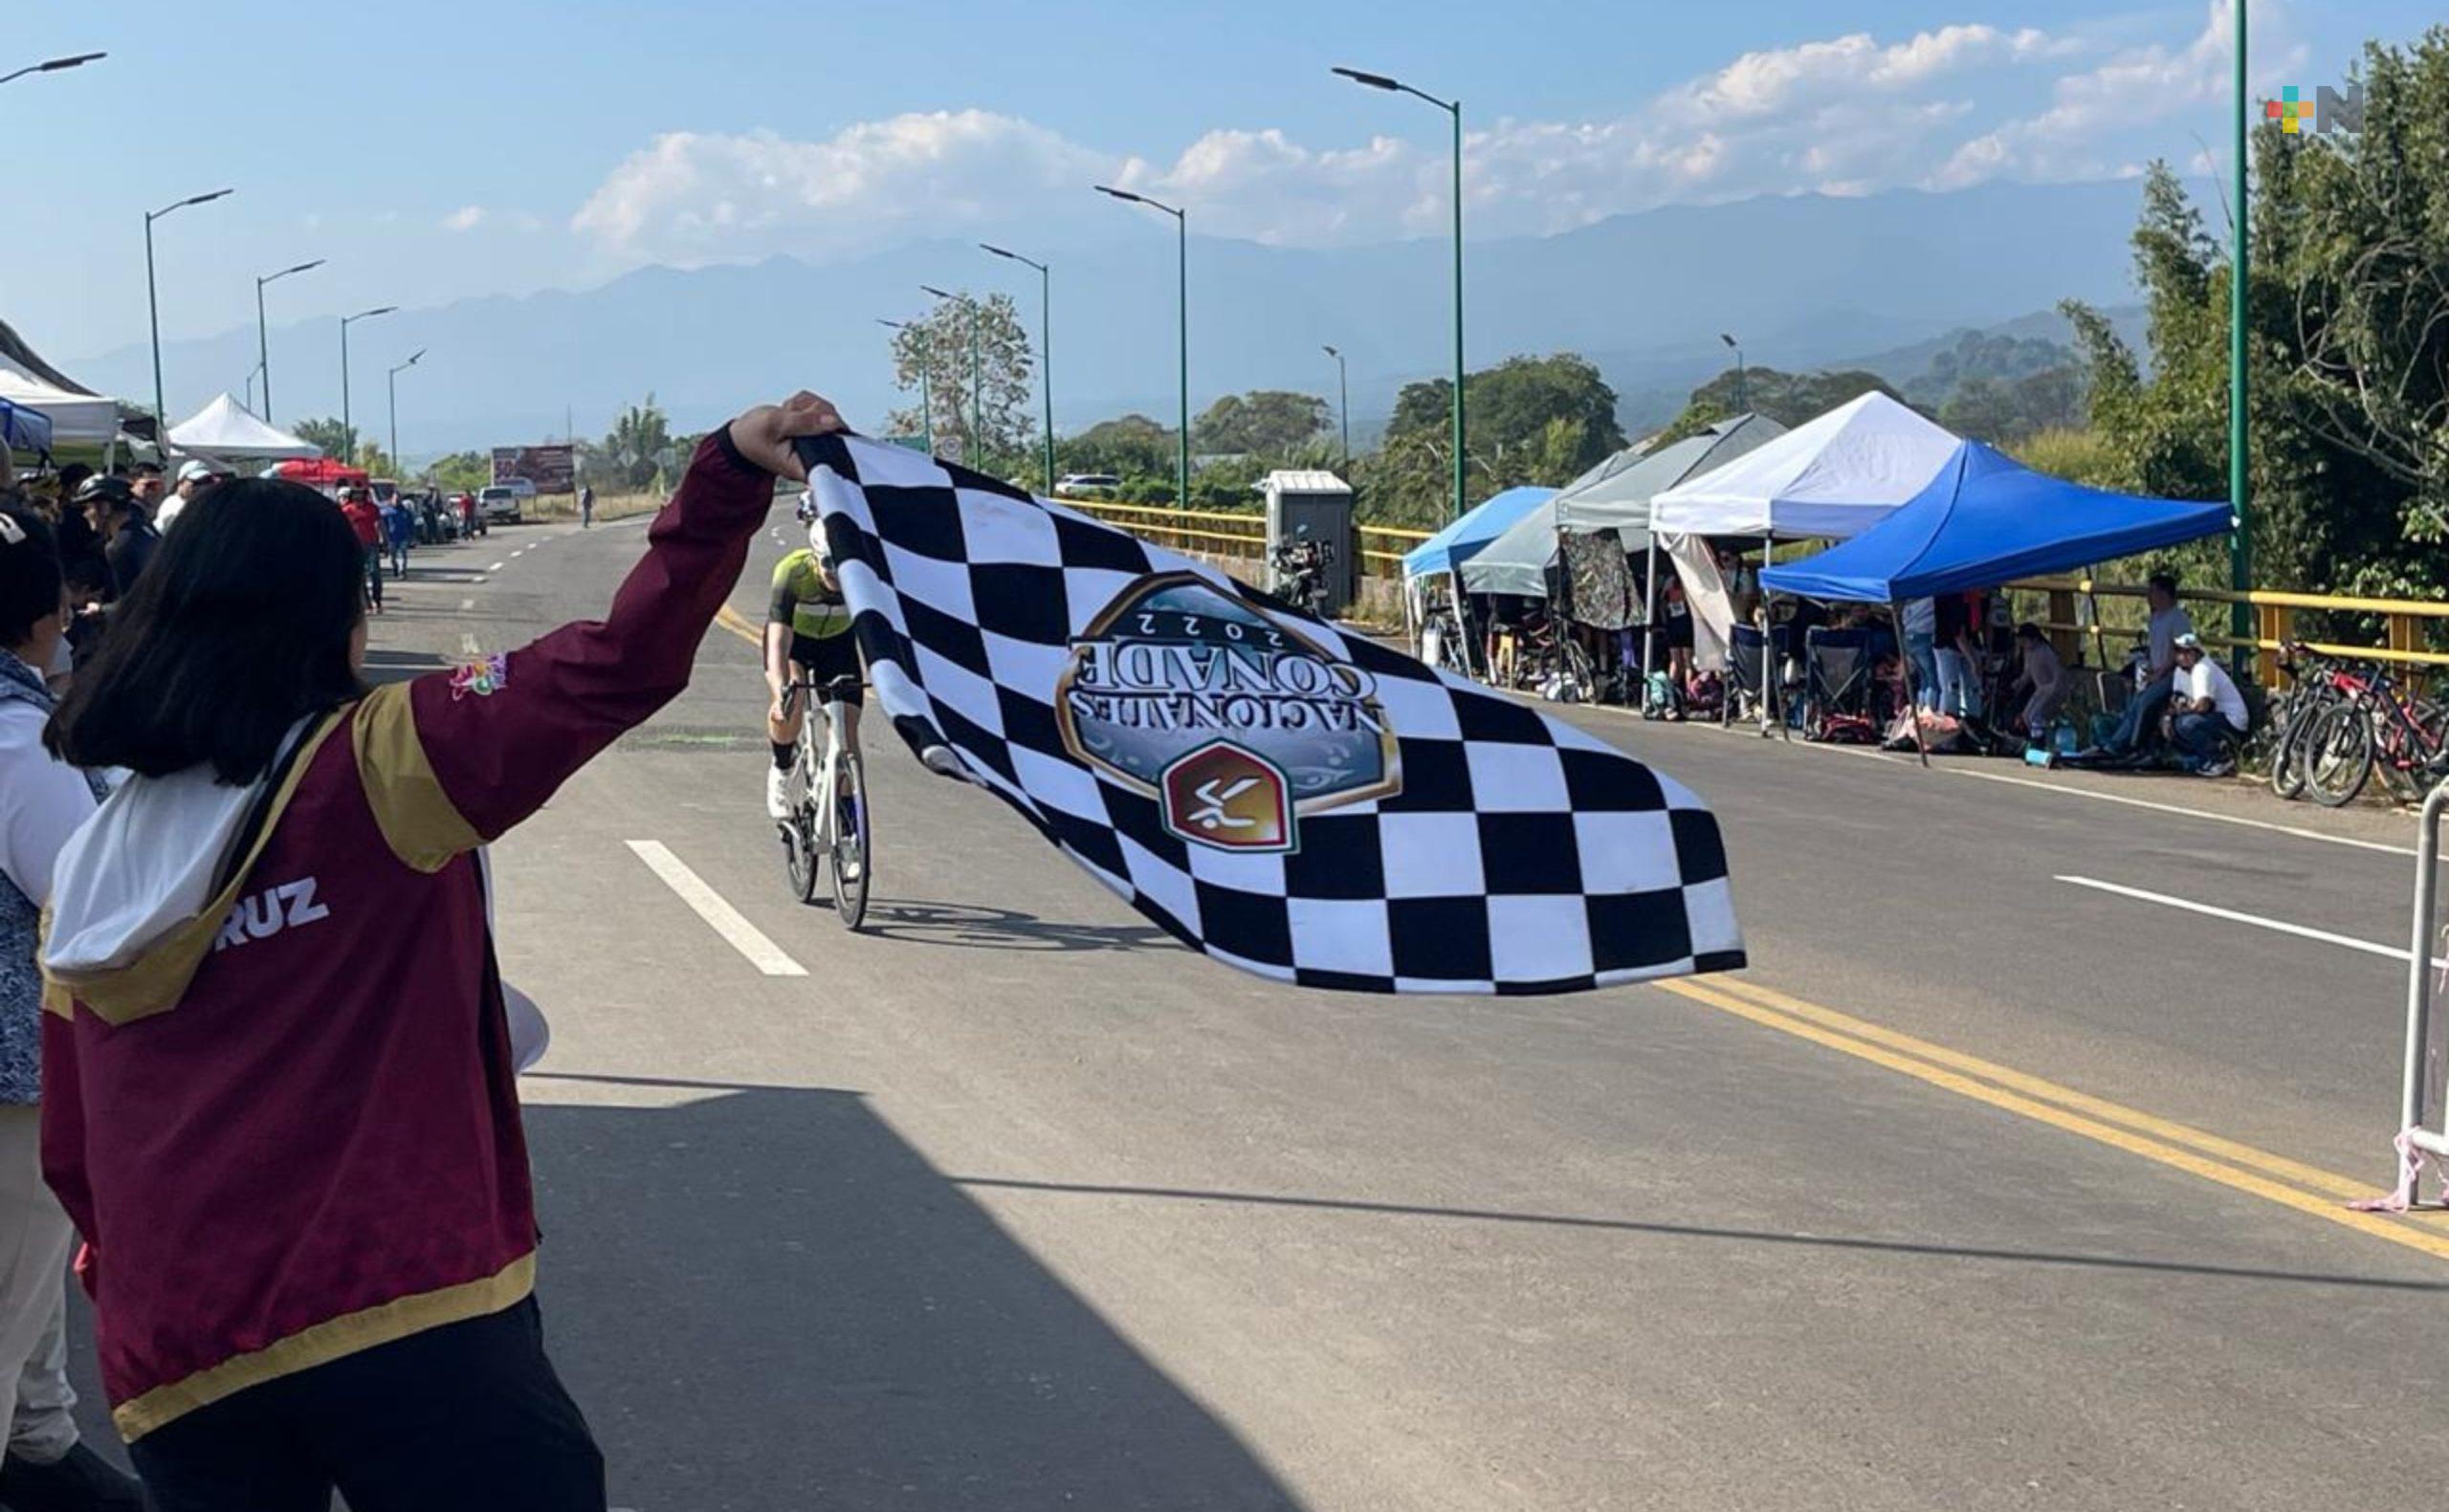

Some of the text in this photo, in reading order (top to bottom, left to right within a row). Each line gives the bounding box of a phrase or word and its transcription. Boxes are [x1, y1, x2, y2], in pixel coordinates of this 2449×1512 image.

[1137, 614, 1284, 647] 2022
[1070, 640, 1378, 699] CONADE
[1067, 690, 1386, 733] NACIONALES
